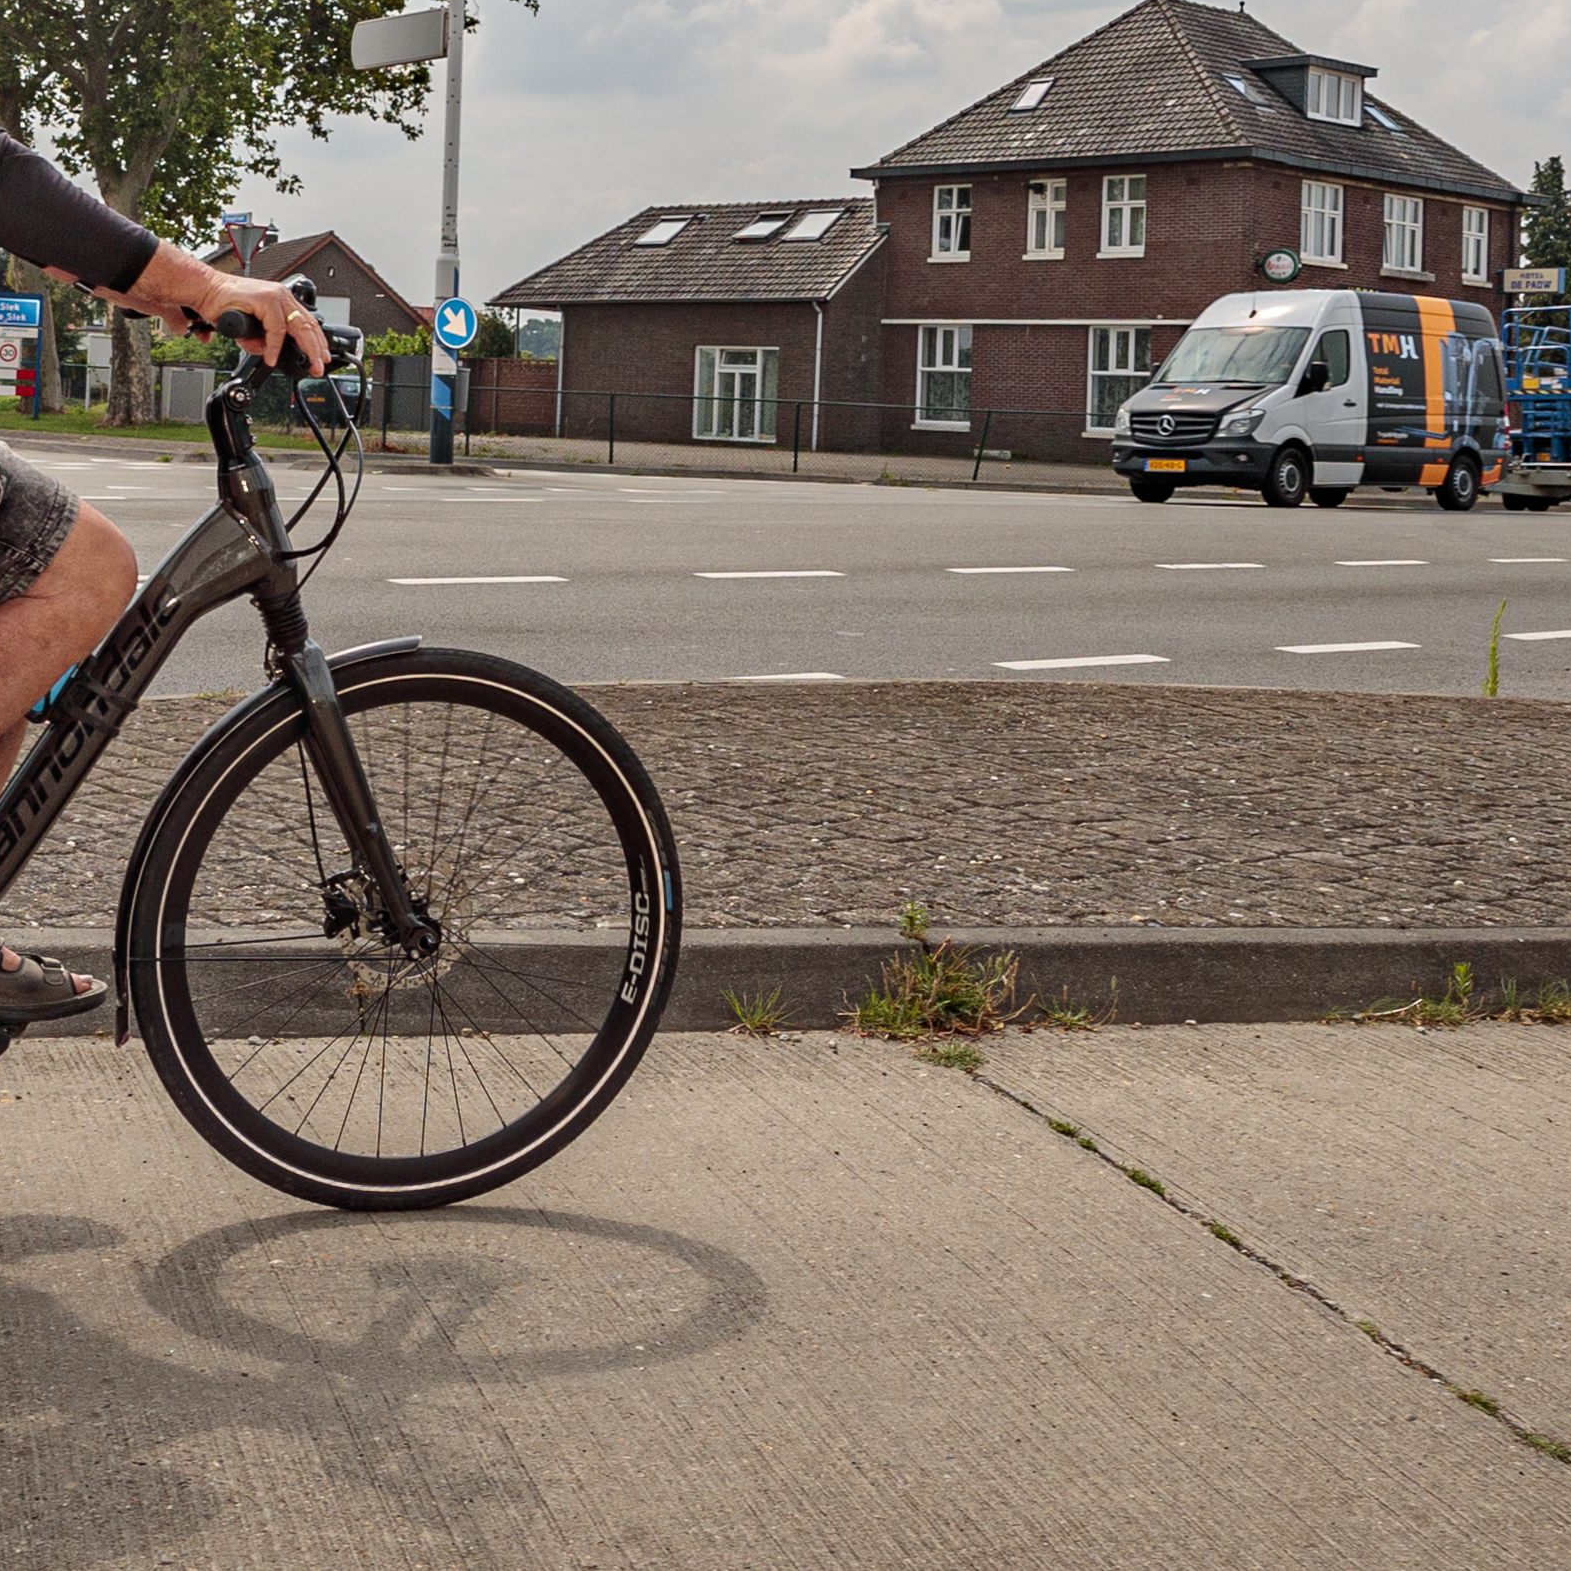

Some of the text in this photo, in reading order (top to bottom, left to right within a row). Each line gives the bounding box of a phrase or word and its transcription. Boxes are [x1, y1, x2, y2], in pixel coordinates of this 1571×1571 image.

[0, 302, 20, 311] Slek
[6, 312, 27, 321] Slek
[1367, 333, 1420, 359] TMH
[2, 349, 15, 357] 30
[620, 891, 650, 1005] E-DISC
